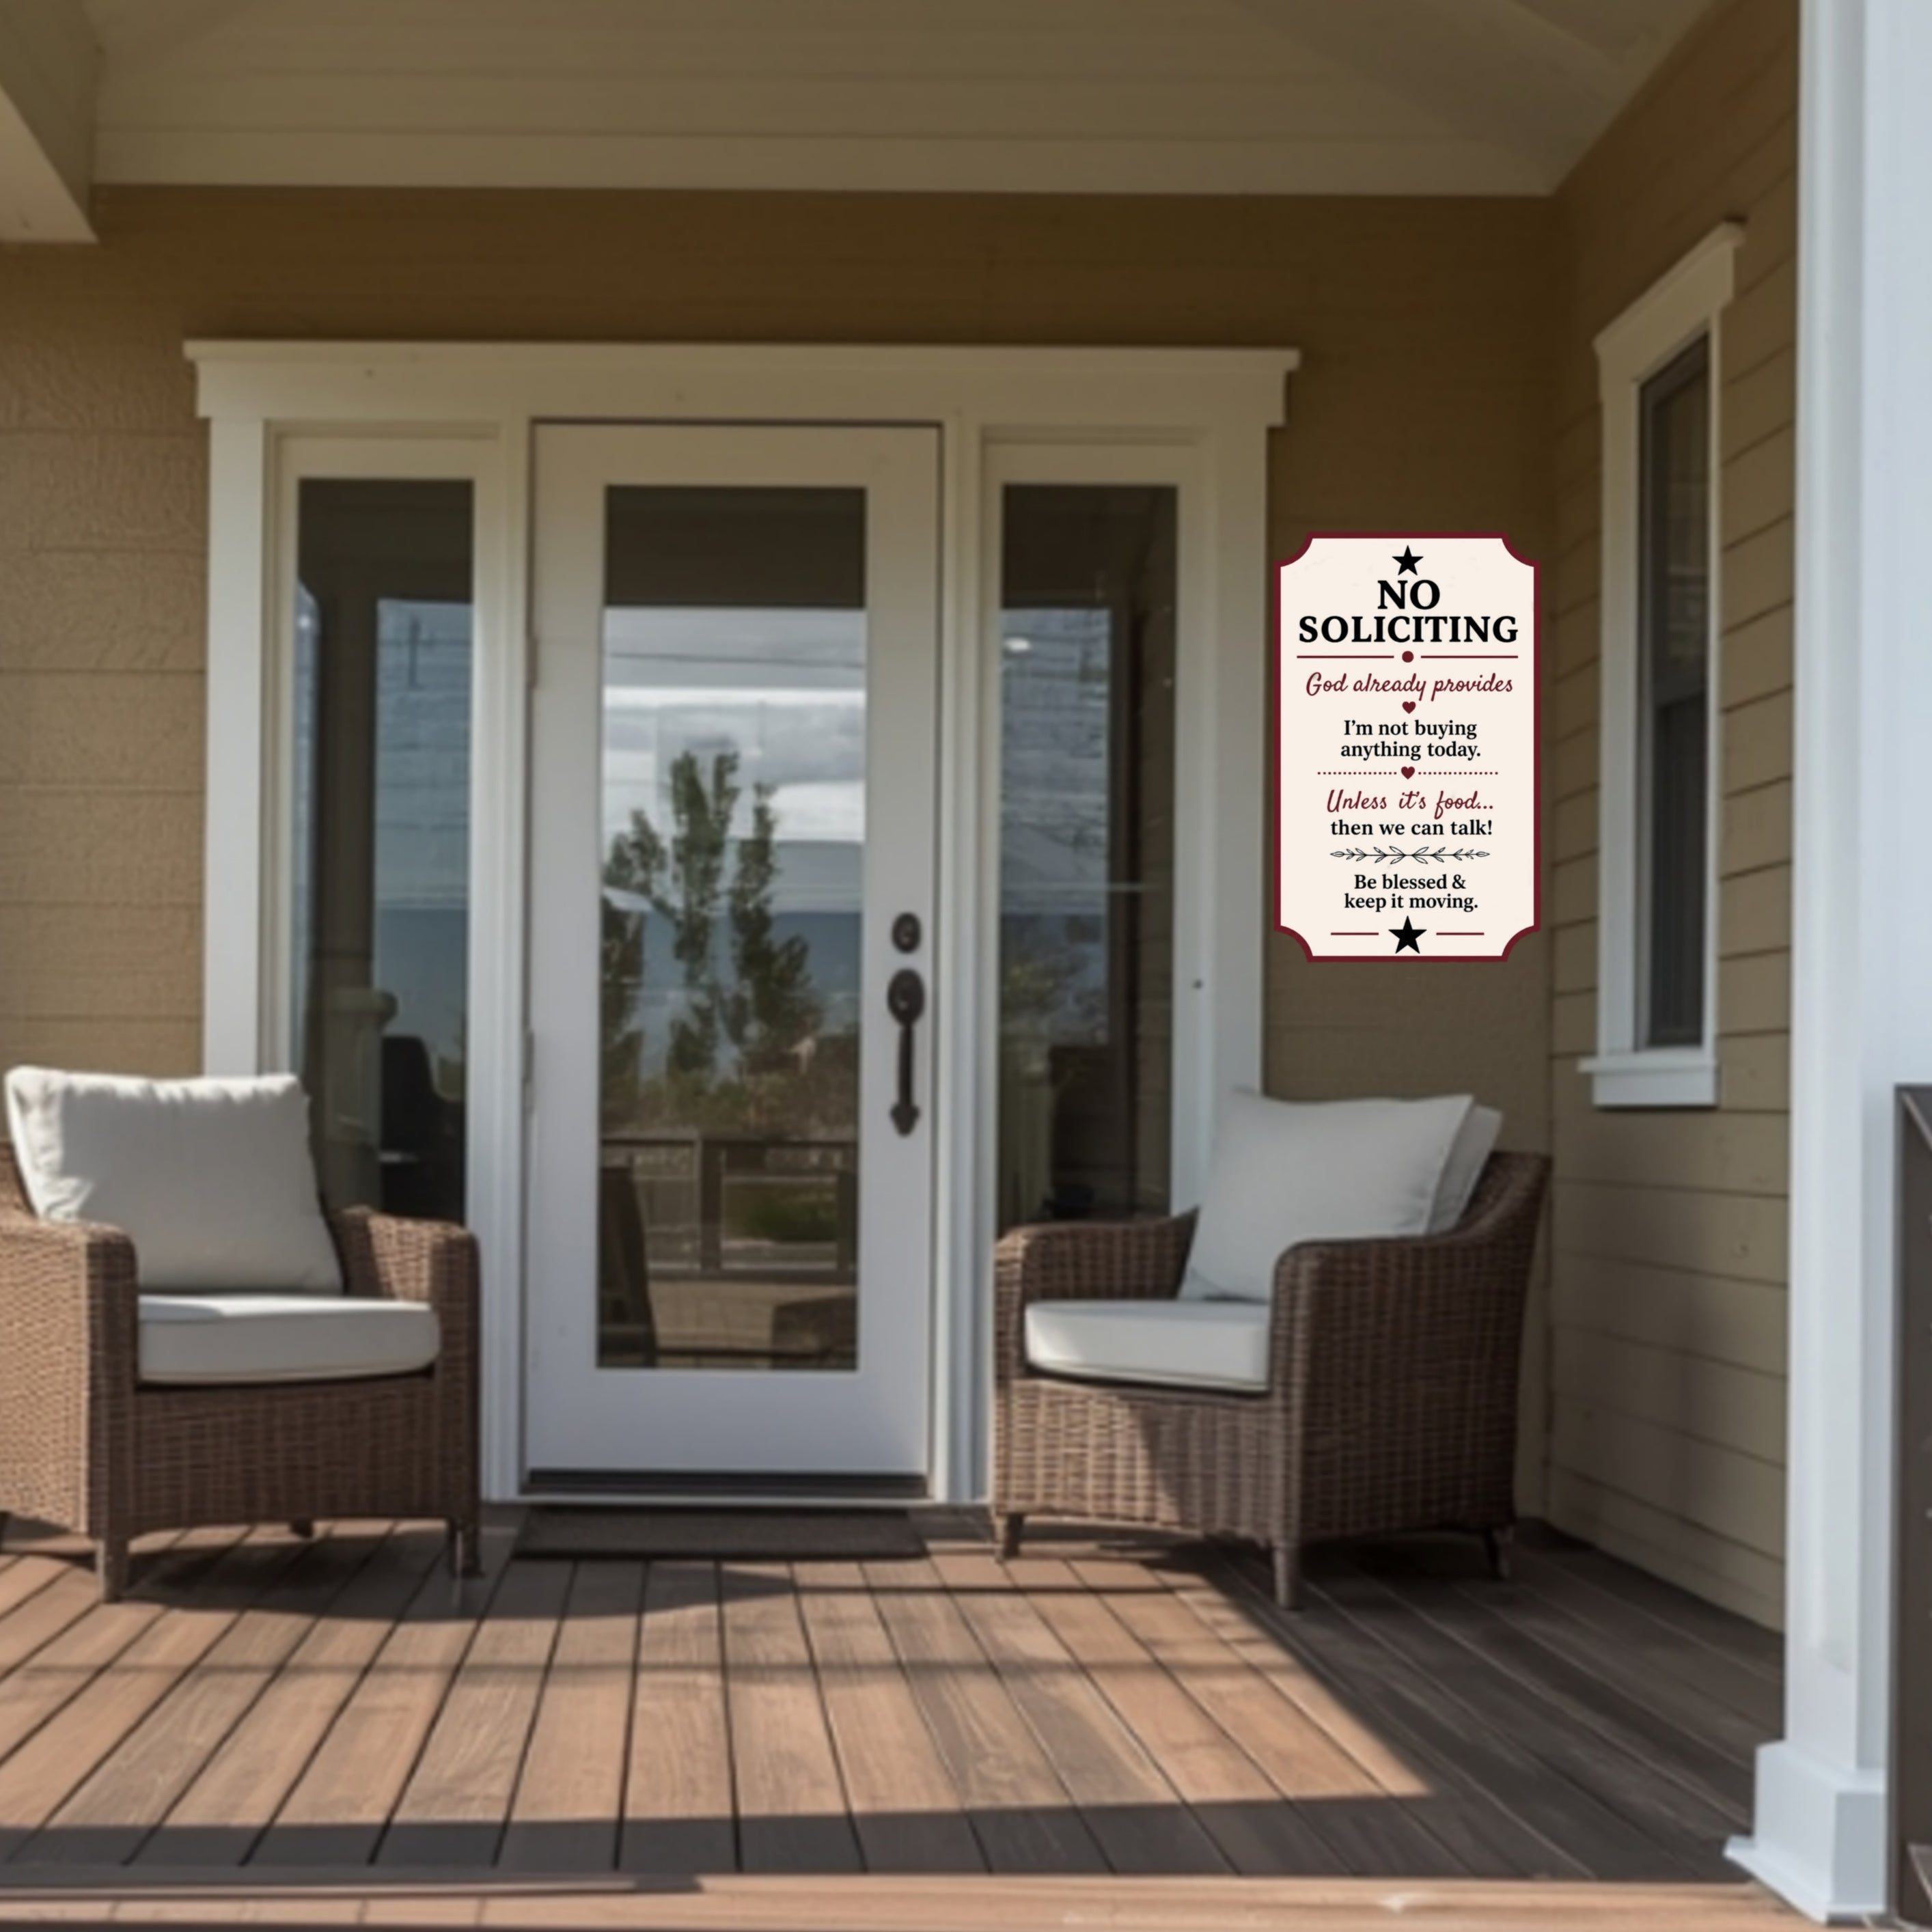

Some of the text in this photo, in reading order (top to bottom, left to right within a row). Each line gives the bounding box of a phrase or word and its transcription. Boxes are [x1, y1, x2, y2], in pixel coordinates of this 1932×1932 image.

[1377, 579, 1440, 610] NO
[1299, 616, 1518, 643] SOLICITING
[1306, 672, 1513, 702] God already provides
[1344, 719, 1477, 740] I'm not buying
[1341, 741, 1480, 761] anything today.
[1327, 789, 1493, 819] Unless it's food...
[1331, 819, 1492, 835] then we can talk!
[1354, 874, 1466, 889] Be blessed &
[1344, 893, 1478, 912] keep it moving.
